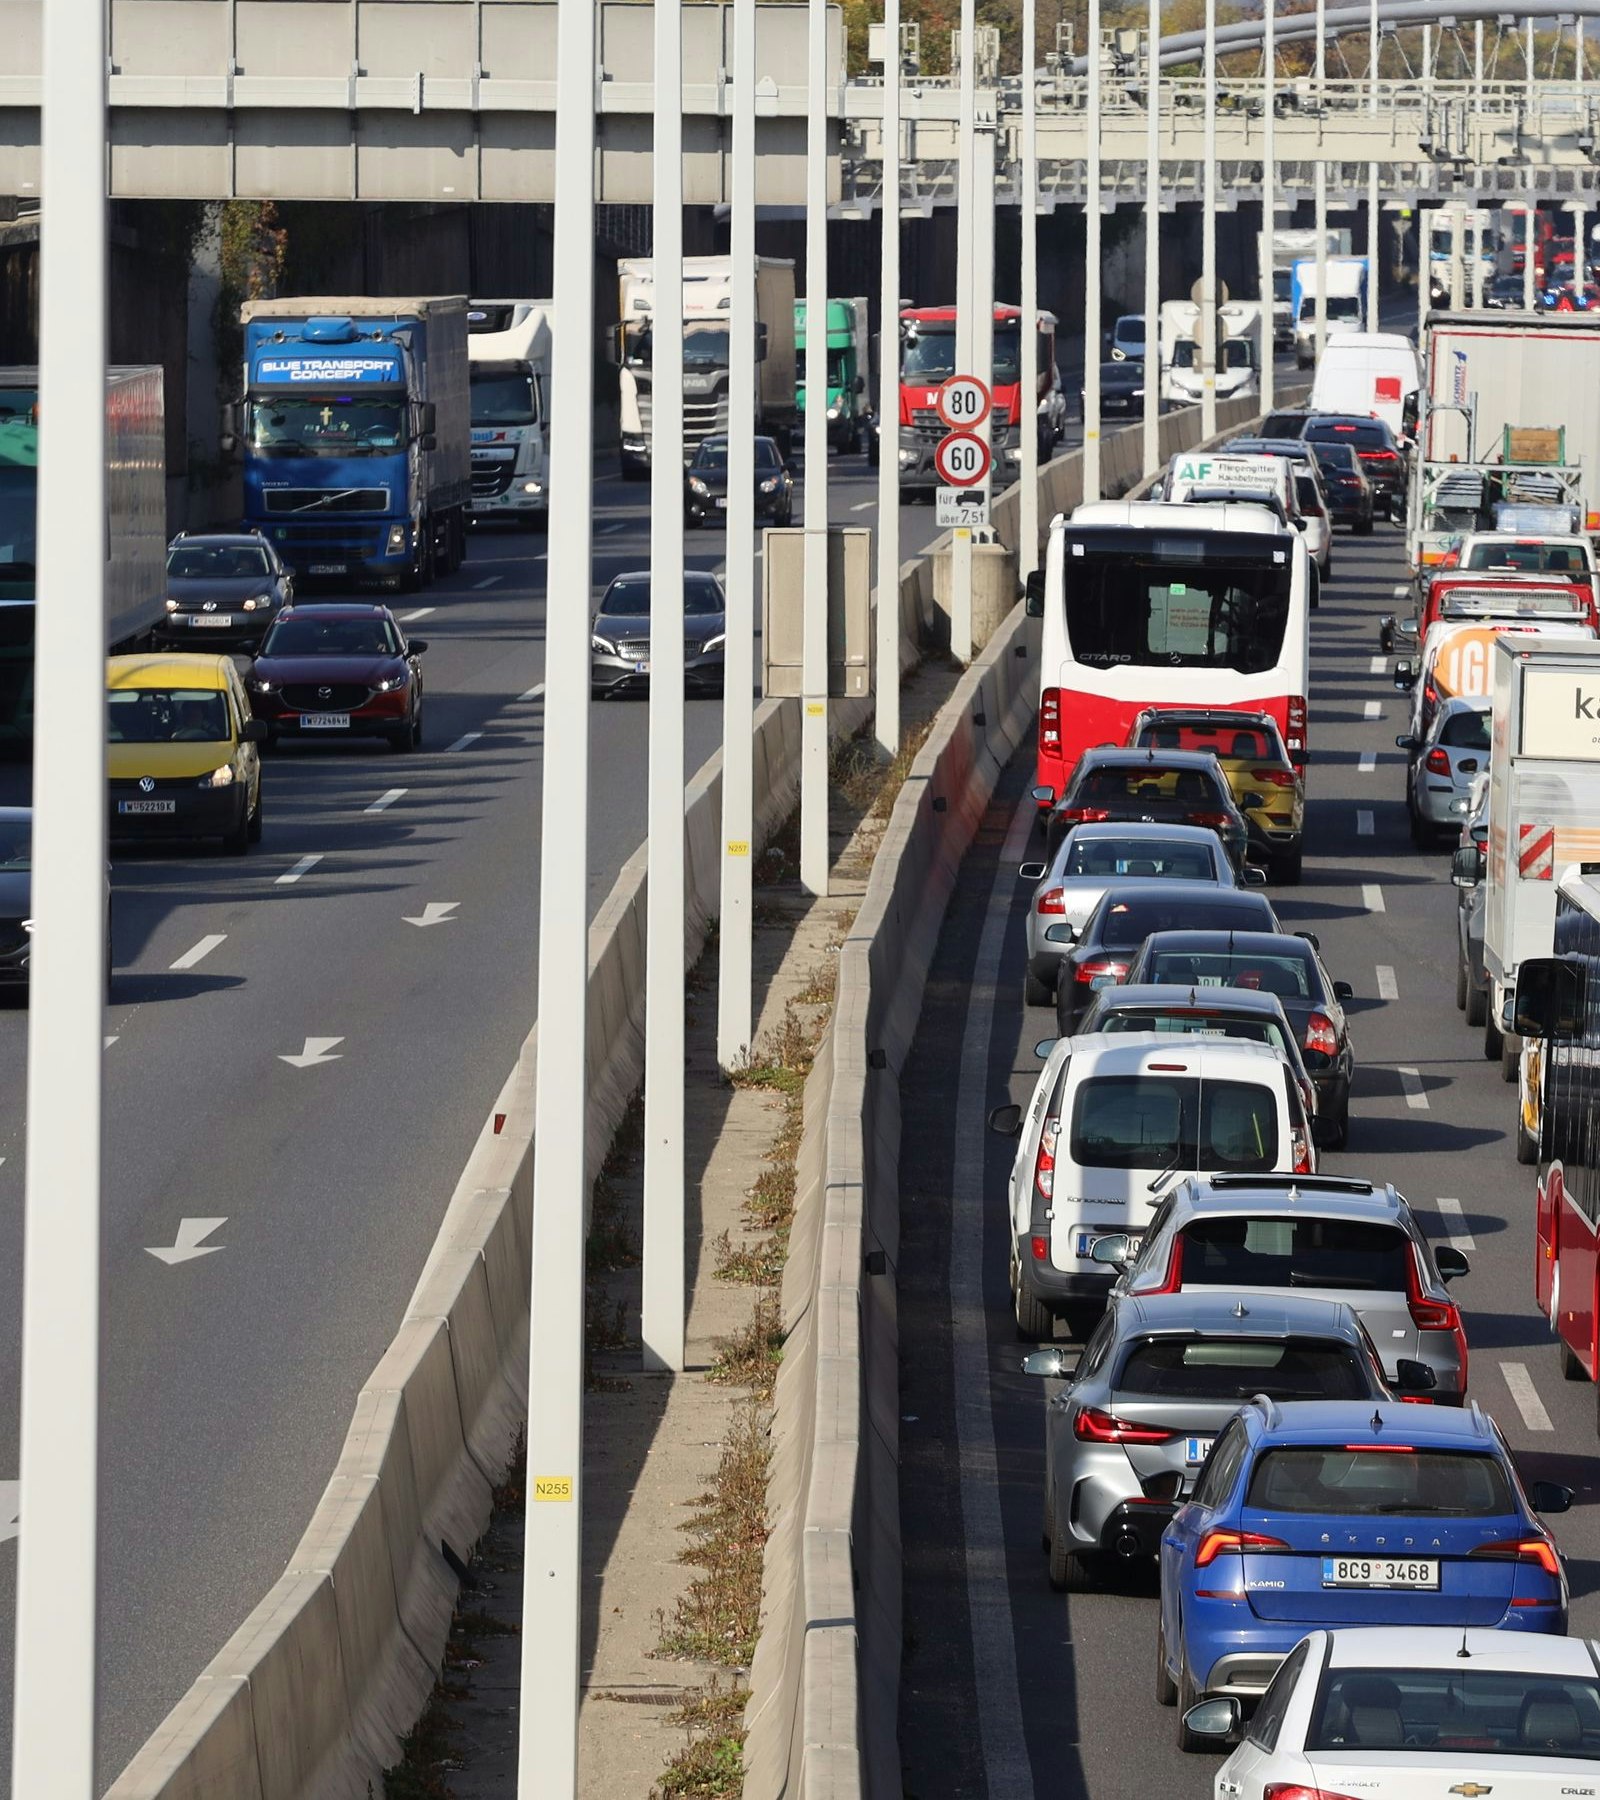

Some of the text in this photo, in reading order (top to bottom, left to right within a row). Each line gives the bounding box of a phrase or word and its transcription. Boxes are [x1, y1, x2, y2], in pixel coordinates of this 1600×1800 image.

[262, 360, 394, 371] BLUE TRANSPORT
[290, 369, 364, 380] CONCEPT
[951, 390, 976, 415] 80
[951, 446, 976, 471] 60
[1179, 463, 1212, 480] AF
[938, 492, 954, 505] für
[940, 512, 960, 524] über
[1079, 653, 1131, 662] CITARO
[535, 1483, 570, 1495] N255
[1320, 1532, 1441, 1546] ŠKODA
[1337, 1561, 1371, 1579] 8C9
[1385, 1563, 1430, 1581] 3468
[1249, 1580, 1285, 1589] KAMIQ
[1560, 1787, 1596, 1796] CRUZE
